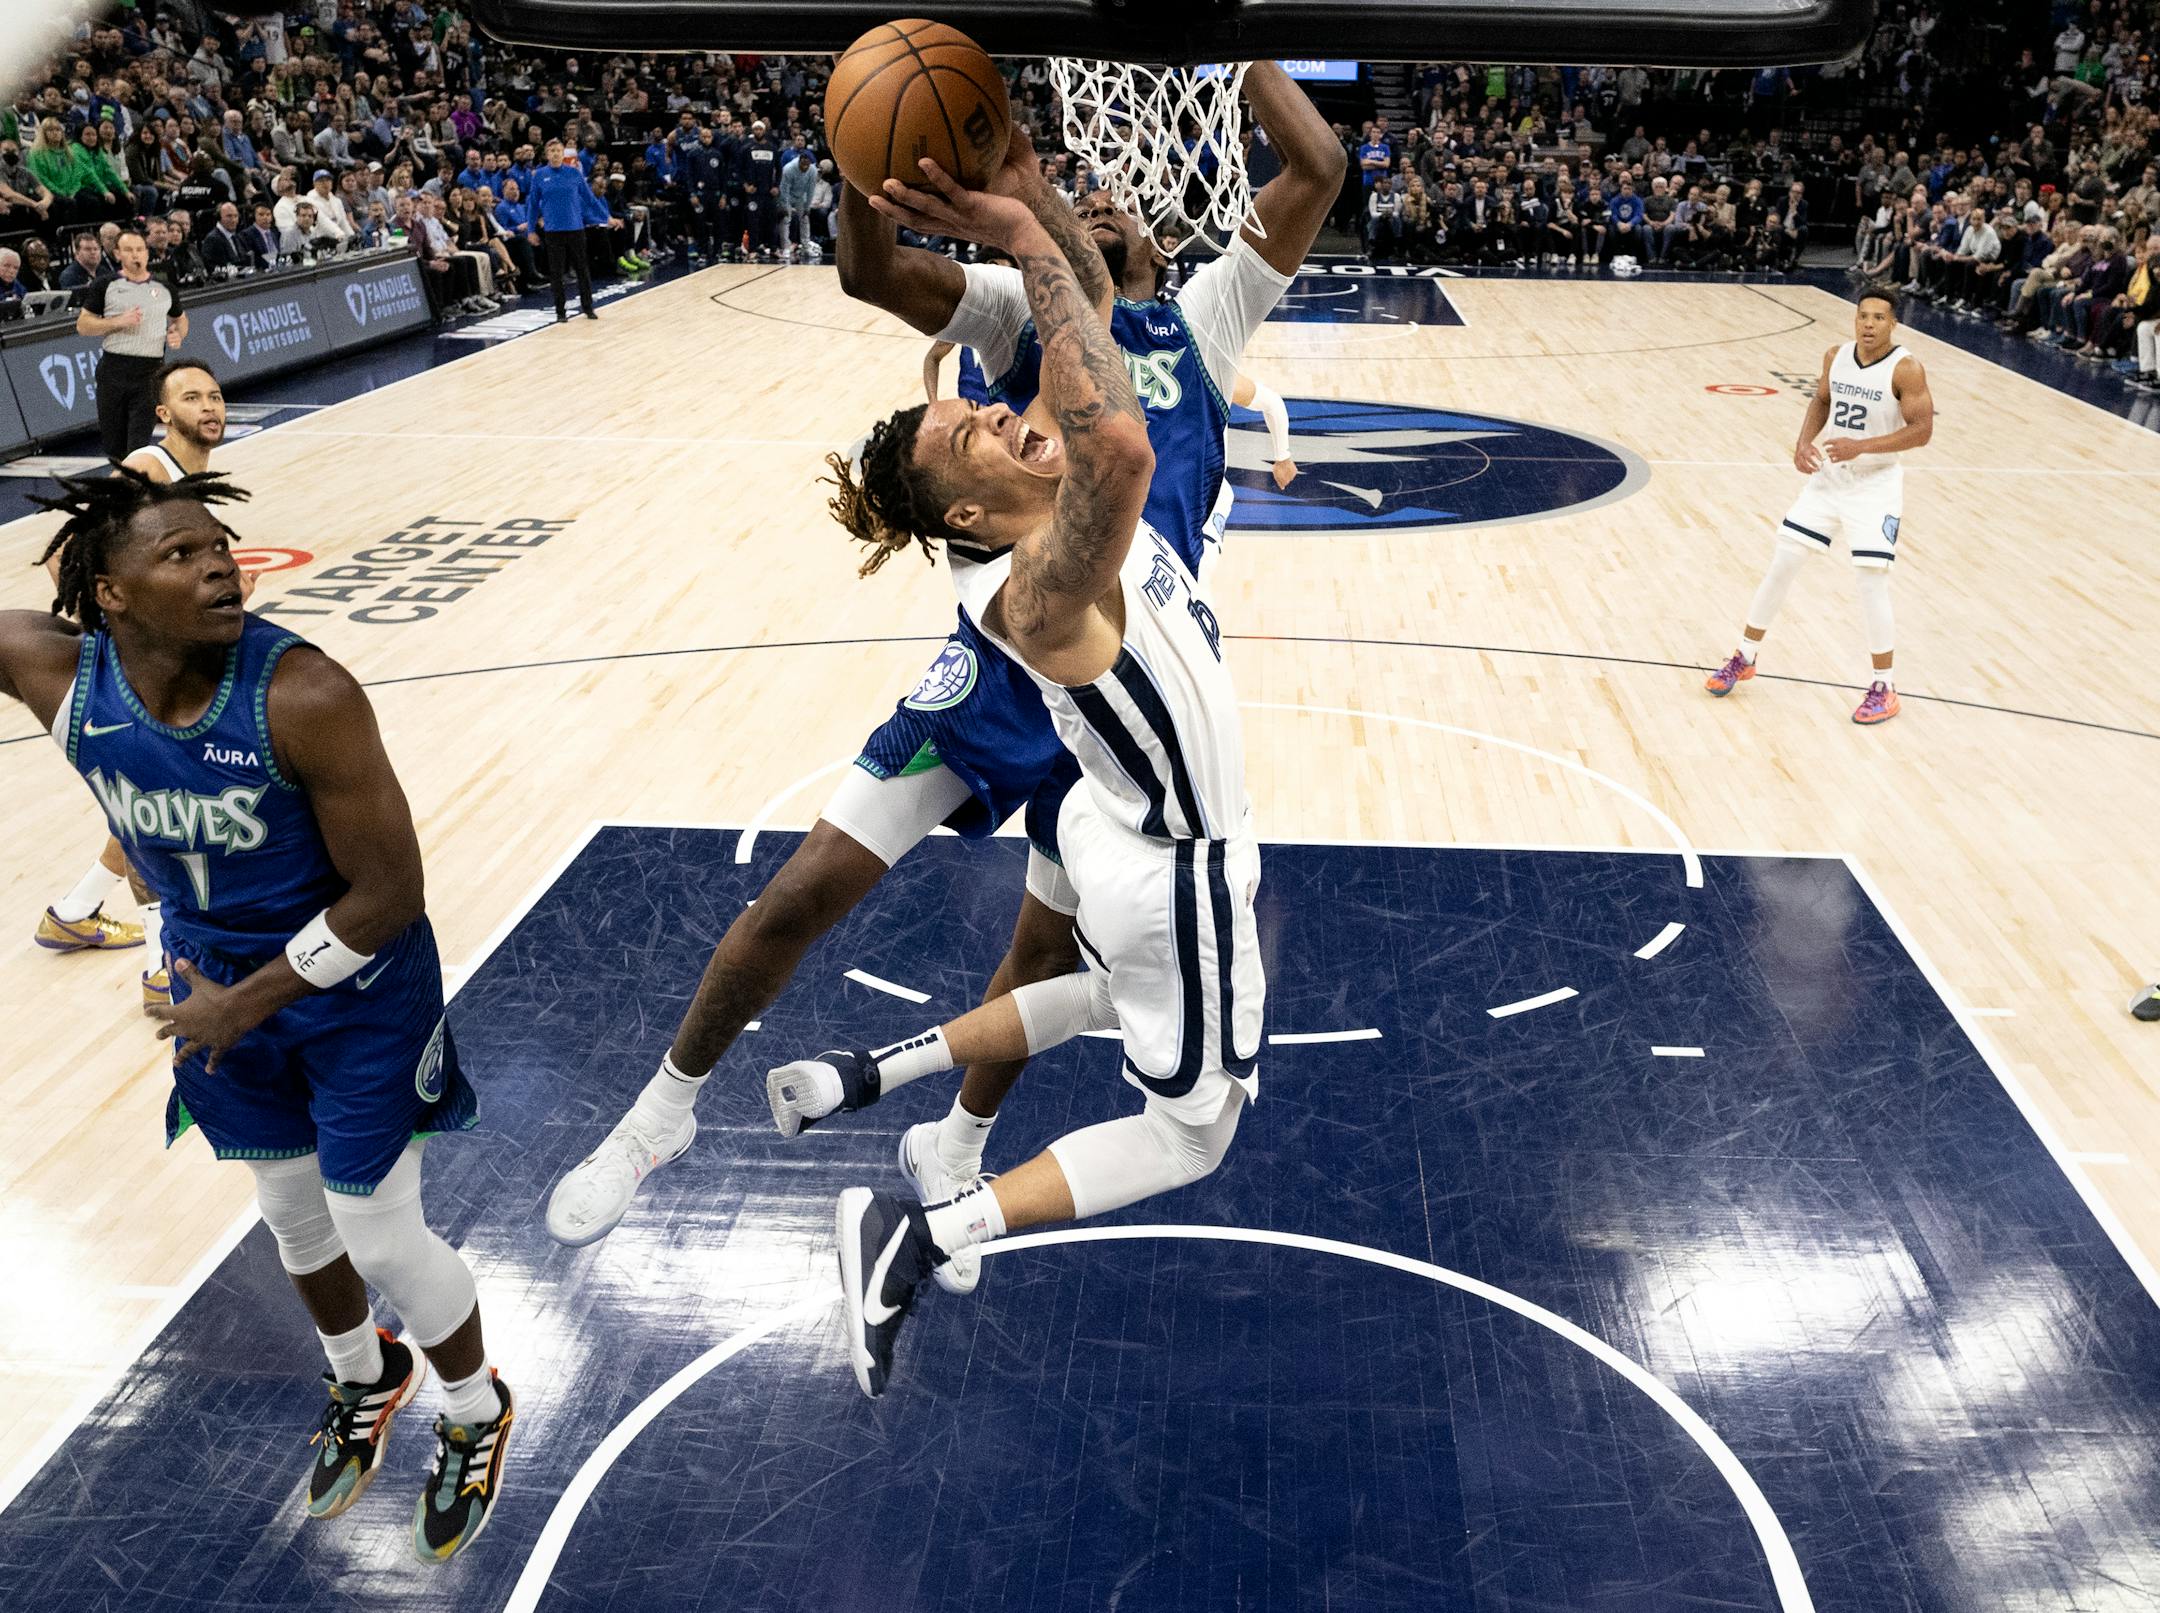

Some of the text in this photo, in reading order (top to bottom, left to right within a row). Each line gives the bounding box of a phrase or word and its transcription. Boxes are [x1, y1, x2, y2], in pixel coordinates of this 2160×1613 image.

[1283, 60, 1326, 73] COM
[366, 273, 417, 304] FANDUEL
[239, 301, 307, 338] FANDUEL
[371, 295, 422, 321] SPORTSBOOK
[247, 326, 312, 355] SPORTSBOOK
[1832, 380, 1883, 402] MEMPHIS
[1834, 401, 1868, 431] 22
[256, 516, 486, 618] TARGET
[347, 518, 577, 624] CENTER
[86, 766, 270, 856] WOLVES
[170, 852, 210, 911] 1
[294, 951, 316, 973] AE
[310, 940, 332, 957] 1
